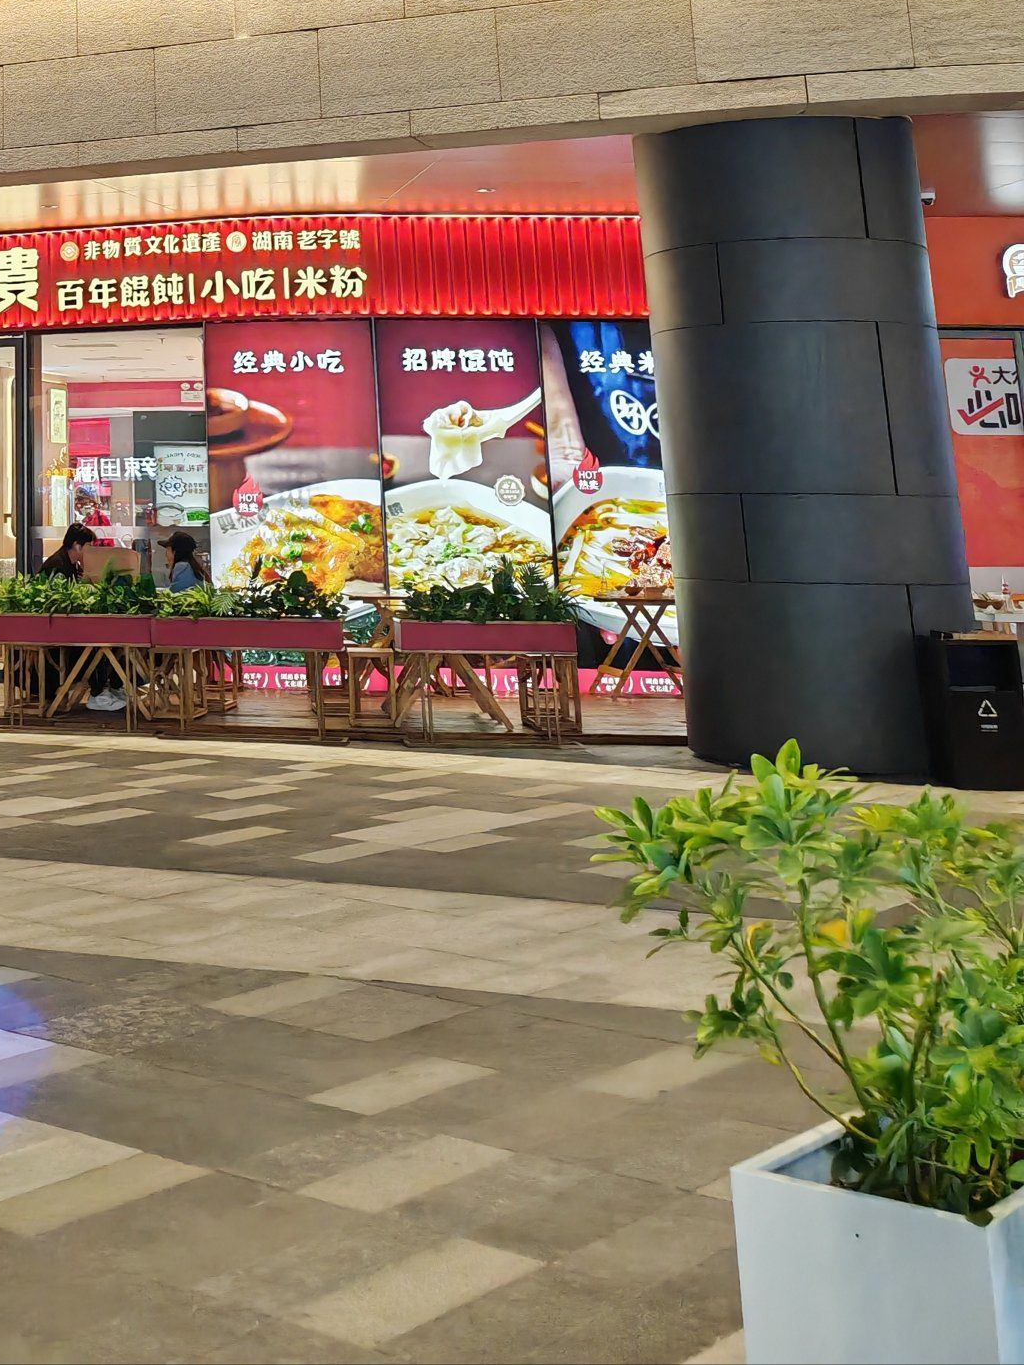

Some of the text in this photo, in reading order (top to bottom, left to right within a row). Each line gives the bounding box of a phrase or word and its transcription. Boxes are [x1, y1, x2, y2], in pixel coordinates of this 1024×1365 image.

[83, 229, 361, 260] 非物質文化遺產 湖南老字號
[233, 349, 345, 374] 经典小吃
[402, 348, 514, 372] 招牌馄饨
[578, 471, 597, 480] HOT
[578, 480, 599, 490] 热卖
[239, 494, 259, 502] HOT
[239, 503, 259, 513] 热卖
